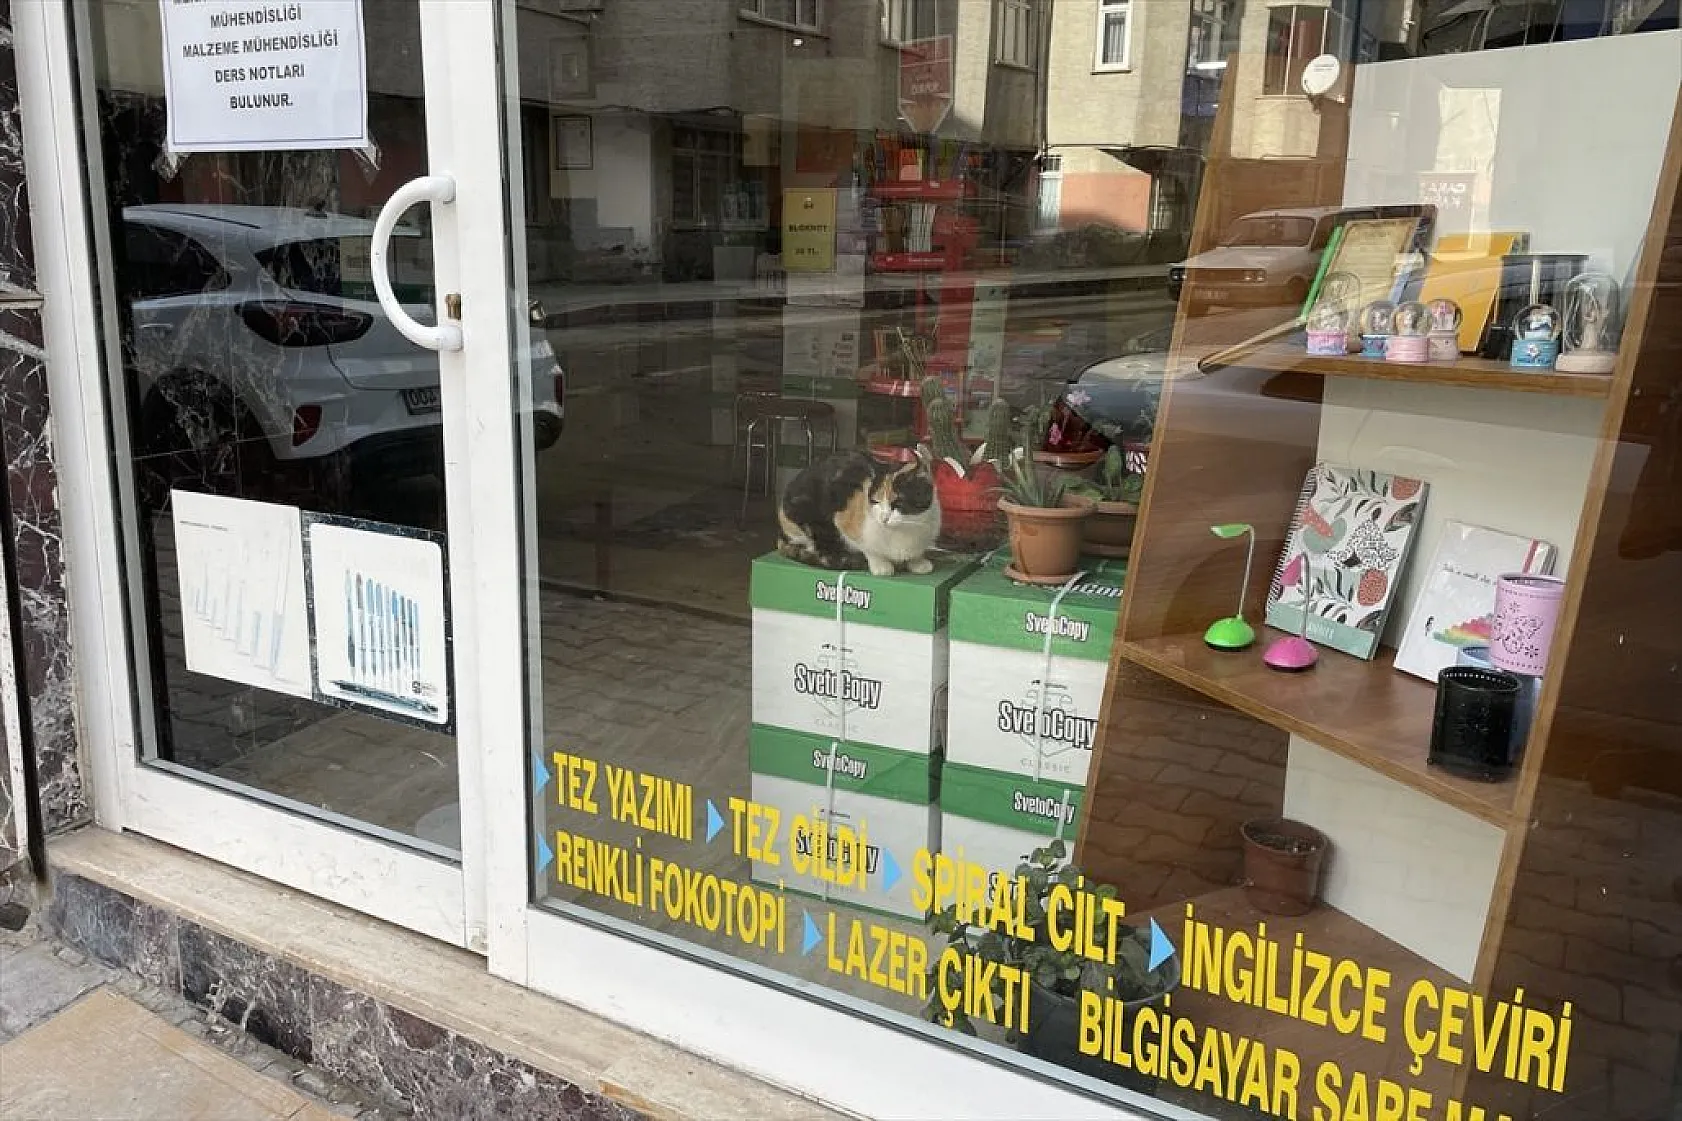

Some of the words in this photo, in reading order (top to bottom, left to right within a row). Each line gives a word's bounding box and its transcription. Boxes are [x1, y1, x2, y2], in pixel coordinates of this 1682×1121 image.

[210, 3, 302, 28] MÜHENDİSLİĞİ
[182, 41, 240, 58] MALZEME
[243, 29, 339, 53] MÜHENDİSLİĞİ
[215, 68, 246, 83] DERS
[249, 63, 305, 81] NOTLARI
[229, 92, 293, 109] BULUNUR.
[815, 580, 871, 609] SveoCopy
[1025, 611, 1090, 642] SveoCopy
[812, 749, 868, 779] SvtoCopy
[1013, 789, 1077, 825] SvetoCoy
[553, 751, 598, 814] TEZ
[605, 764, 693, 841] YAZIMI
[728, 796, 781, 865] TEZ
[789, 803, 870, 893] CİLDİ
[911, 844, 1036, 942] SPİRAL
[1047, 875, 1127, 963] CİLT
[1181, 902, 1392, 1044] İNGİLİZCE
[1403, 979, 1573, 1093] ÇEVİRİ
[555, 830, 643, 907] RENKLİ
[649, 857, 787, 954] FOKOTOPİ
[826, 912, 929, 1001] LAZER
[937, 947, 1032, 1034] ÇIKTI
[1079, 976, 1302, 1121] BİLGİSAYAR
